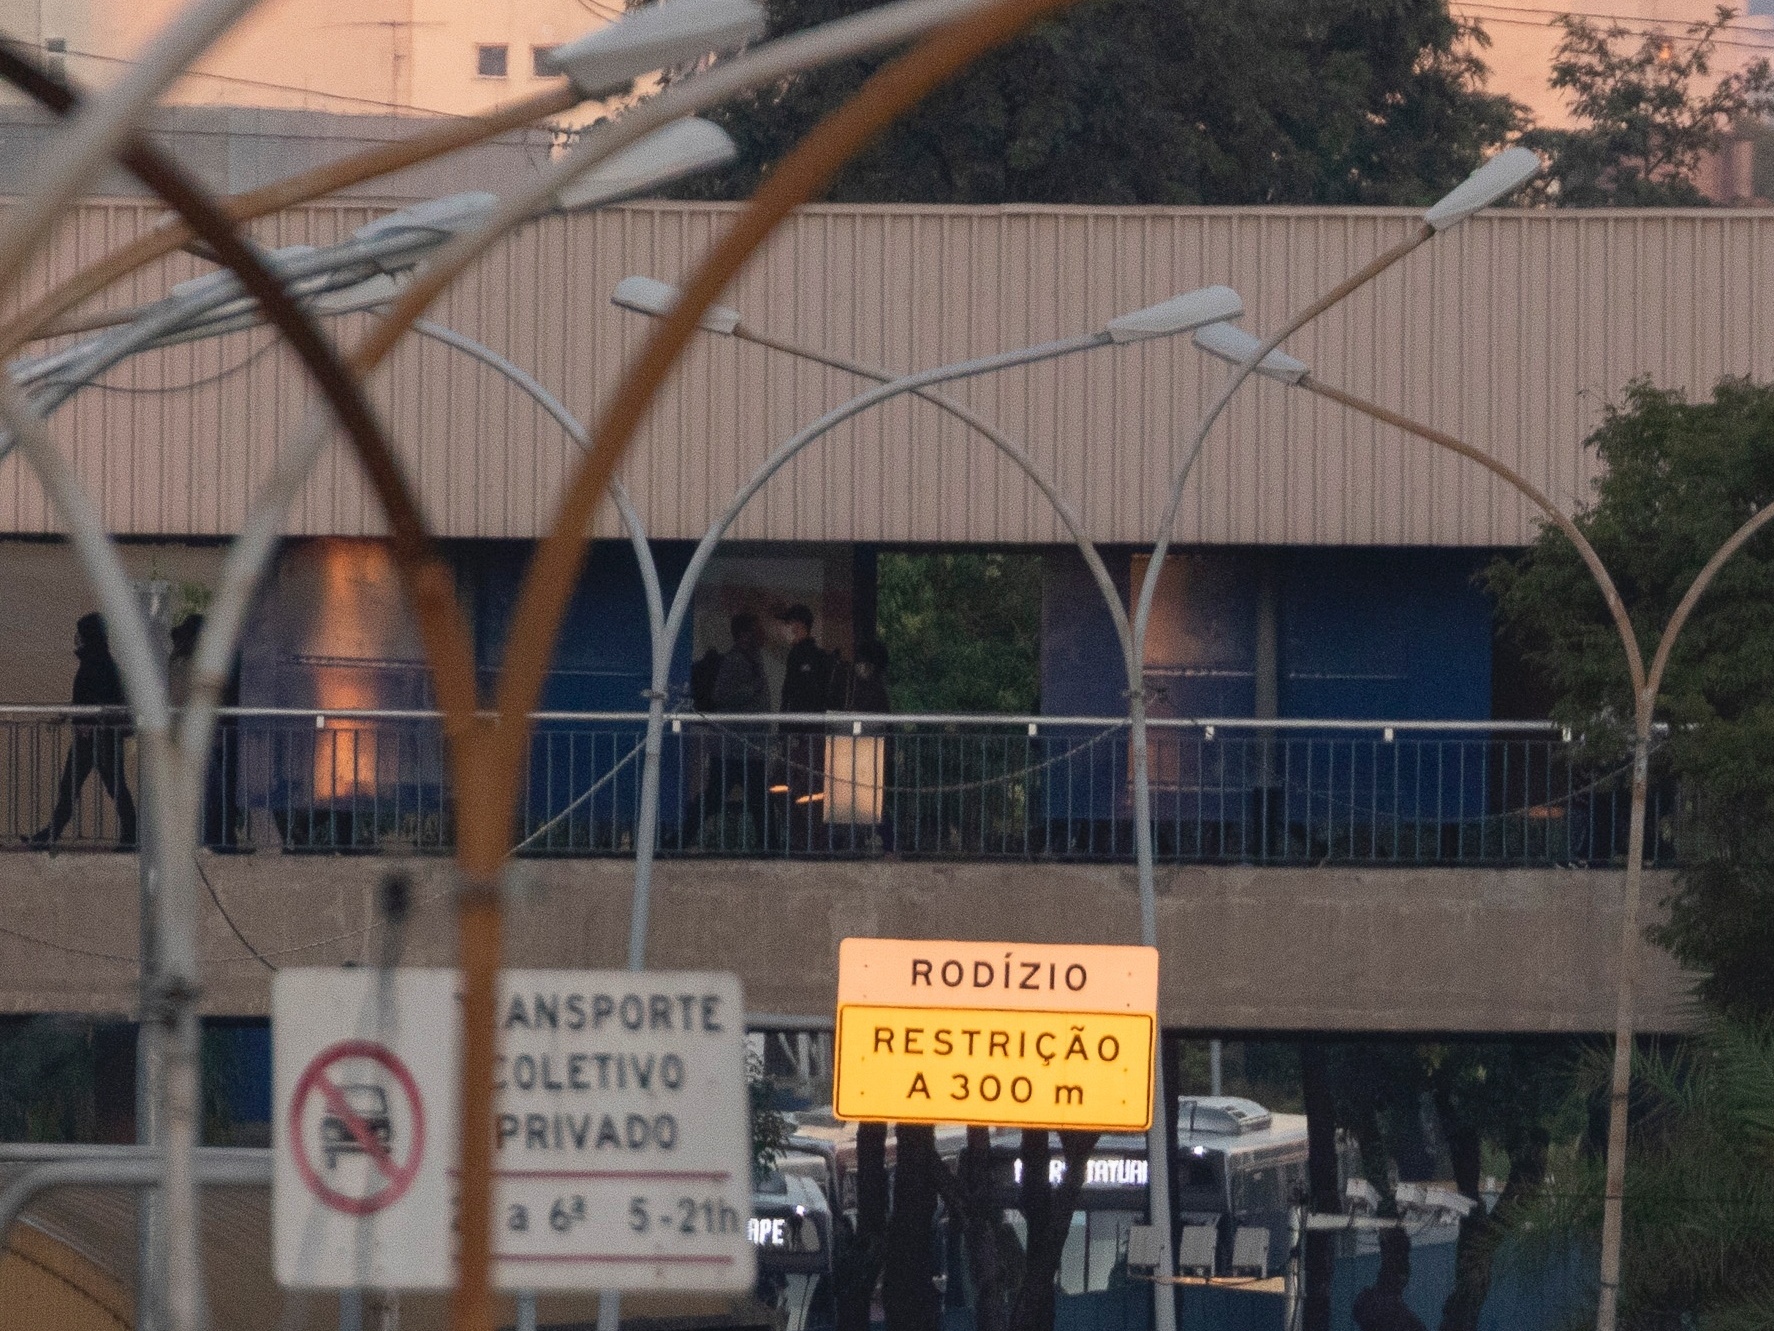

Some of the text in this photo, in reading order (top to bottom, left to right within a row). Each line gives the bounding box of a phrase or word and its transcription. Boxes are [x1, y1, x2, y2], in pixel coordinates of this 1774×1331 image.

[911, 952, 1088, 992] RODÍZIO
[873, 1024, 1120, 1067] RESTRIÇÃO
[906, 1071, 1083, 1106] A 300 m
[496, 1113, 679, 1152] PRIVADO
